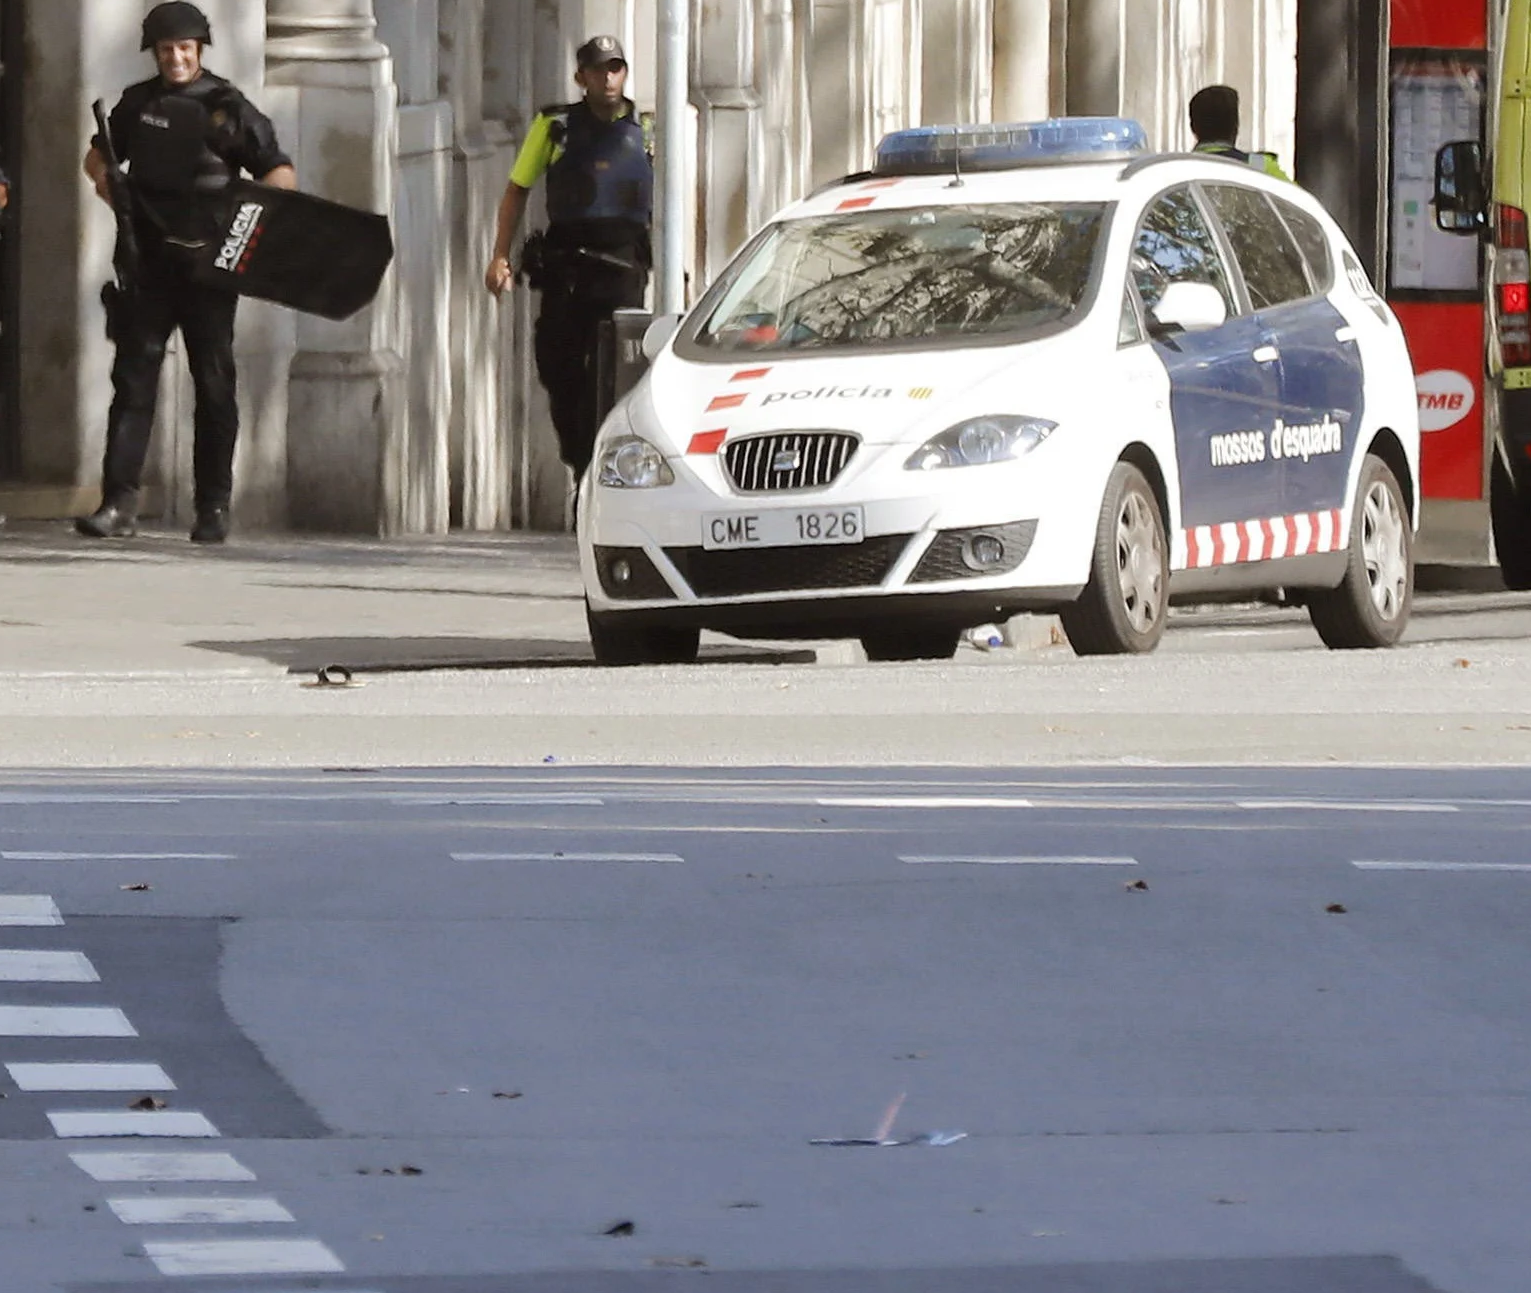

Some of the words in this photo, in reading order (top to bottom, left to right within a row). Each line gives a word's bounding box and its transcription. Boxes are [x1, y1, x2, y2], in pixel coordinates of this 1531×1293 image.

[1210, 429, 1265, 467] mossos
[1270, 413, 1342, 463] d'esquadra
[711, 514, 760, 544] CME
[795, 511, 857, 540] 1826
